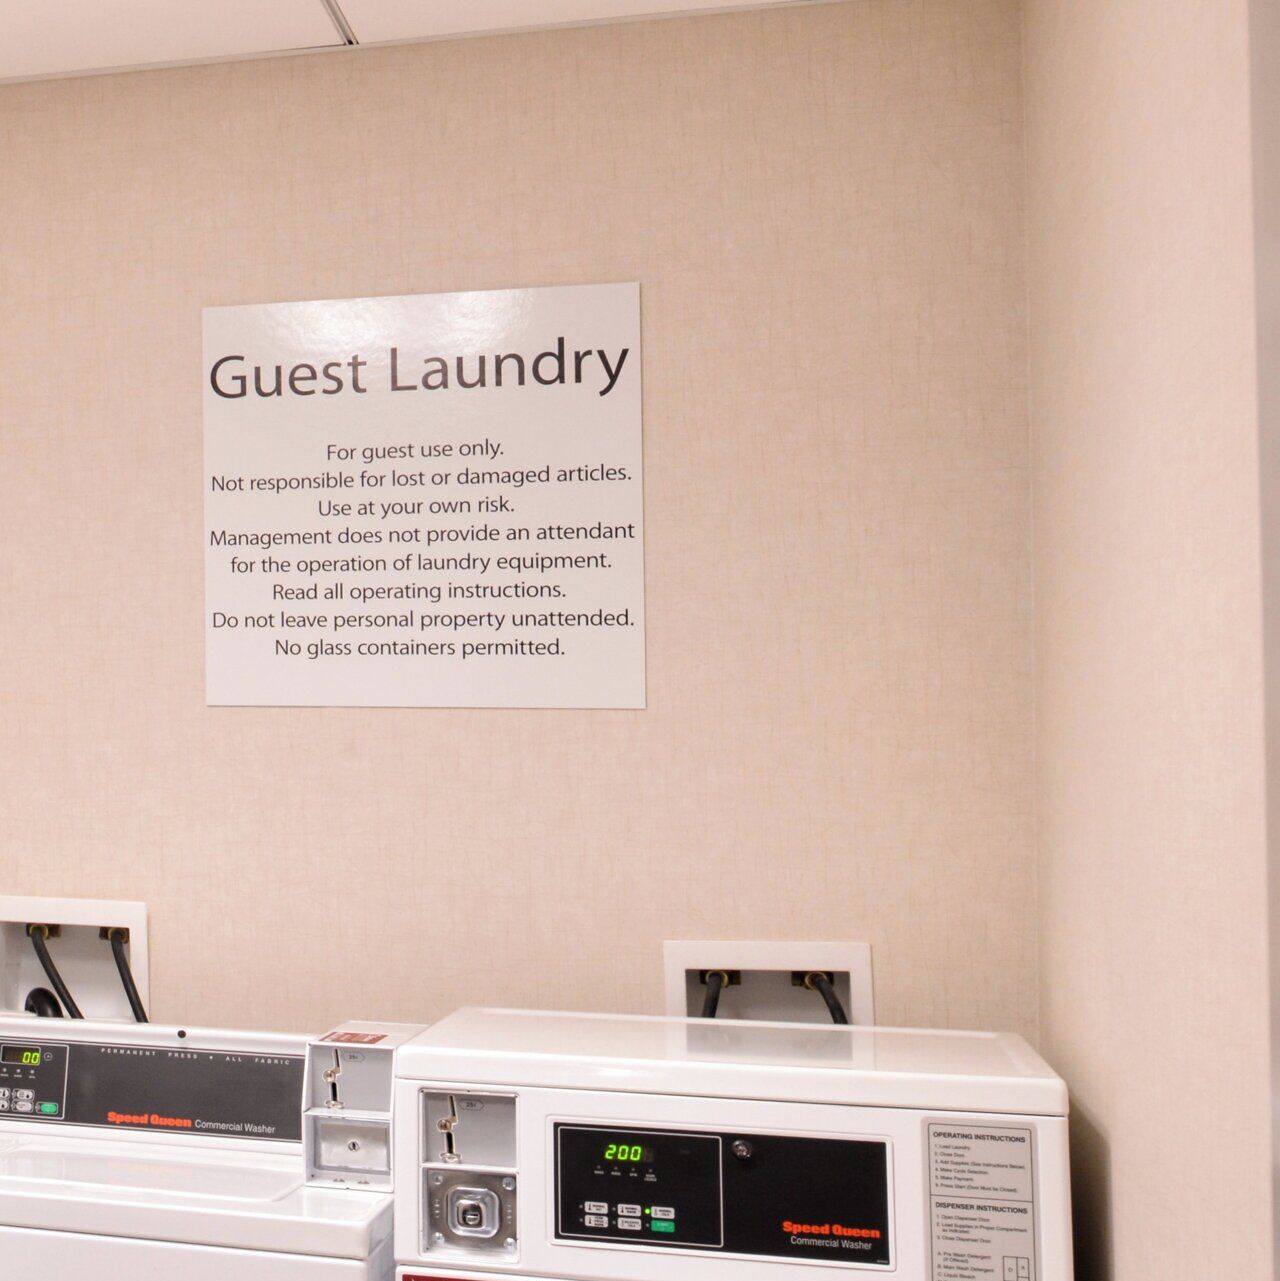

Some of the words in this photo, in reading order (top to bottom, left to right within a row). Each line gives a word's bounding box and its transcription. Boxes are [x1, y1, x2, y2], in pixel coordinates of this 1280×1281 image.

[210, 355, 367, 399] Guest
[390, 337, 629, 397] Laundry
[327, 445, 356, 460] For
[362, 444, 414, 464] guest
[421, 445, 453, 457] use
[459, 438, 504, 460] only.
[212, 476, 244, 491] Not
[251, 472, 354, 494] responsible
[360, 470, 386, 487] for
[392, 470, 425, 486] lost
[431, 473, 451, 485] or
[457, 465, 549, 488] damaged
[557, 463, 631, 482] articles.
[319, 500, 351, 516] Use
[358, 501, 375, 515] at
[381, 502, 423, 519] your
[429, 501, 470, 514] own
[478, 495, 514, 512] risk.
[211, 530, 332, 549] Management
[338, 527, 382, 543] does
[389, 528, 420, 542] not
[427, 524, 500, 546] provide
[506, 528, 529, 540] an
[537, 522, 635, 540] attendant
[230, 557, 256, 573] for
[261, 556, 290, 573] the
[297, 555, 386, 576] operation
[393, 554, 413, 571] of
[418, 553, 491, 574] laundry
[497, 553, 611, 573] equipment.
[273, 583, 317, 600] Read
[324, 583, 343, 599] all
[350, 583, 441, 603] operating
[449, 581, 566, 598] instructions.
[213, 612, 238, 628] Do
[245, 614, 275, 628] not
[281, 611, 327, 627] leave
[334, 610, 413, 631] personal
[421, 612, 505, 631] property
[512, 608, 634, 626] unattended.
[276, 640, 301, 655] No
[307, 639, 351, 659] glass
[358, 639, 455, 655] containers
[463, 638, 565, 659] permitted.
[22, 1052, 40, 1064] 00
[101, 1048, 156, 1056] PERMANENT
[107, 1111, 149, 1124] Speed
[150, 1114, 191, 1127] Queen
[195, 1119, 241, 1131] Commercial
[245, 1123, 276, 1134] Washer
[974, 1135, 1026, 1143] INSTRUCTIONS
[605, 1144, 642, 1160] 200
[936, 1202, 974, 1210] DISPENSER
[976, 1204, 1028, 1214] INSTRUCTIONS
[782, 1221, 830, 1234] Speed
[832, 1224, 881, 1238] Queen
[791, 1236, 839, 1247] Commercial
[841, 1240, 872, 1250] Washer
